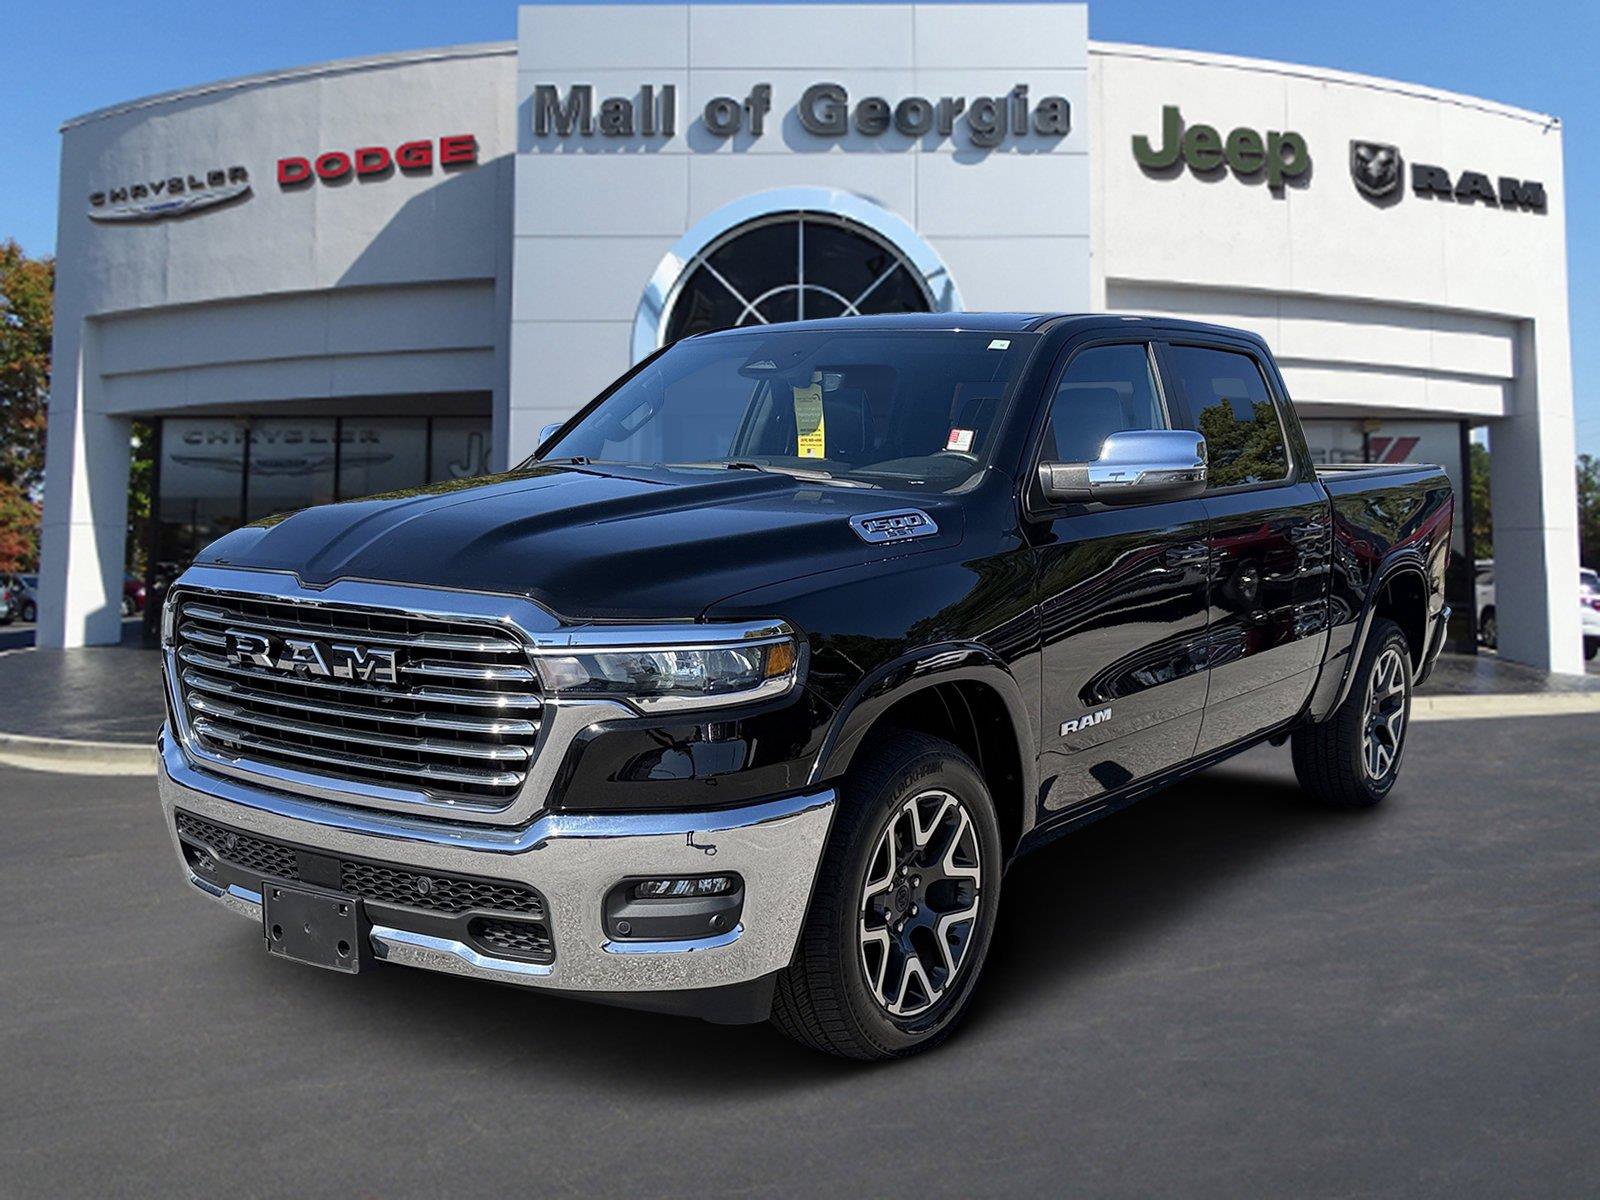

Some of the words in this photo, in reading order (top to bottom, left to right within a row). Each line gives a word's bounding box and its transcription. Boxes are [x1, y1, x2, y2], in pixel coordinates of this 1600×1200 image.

[533, 83, 677, 138] Mall
[703, 82, 772, 138] of
[799, 82, 1072, 149] Georgia
[277, 134, 478, 190] DODGE
[1131, 104, 1310, 190] Jeep
[88, 166, 250, 208] CHRYSLER
[1410, 162, 1548, 212] RAM
[863, 514, 923, 534] 1500
[225, 628, 398, 684] RAM
[1059, 707, 1112, 738] RAM
